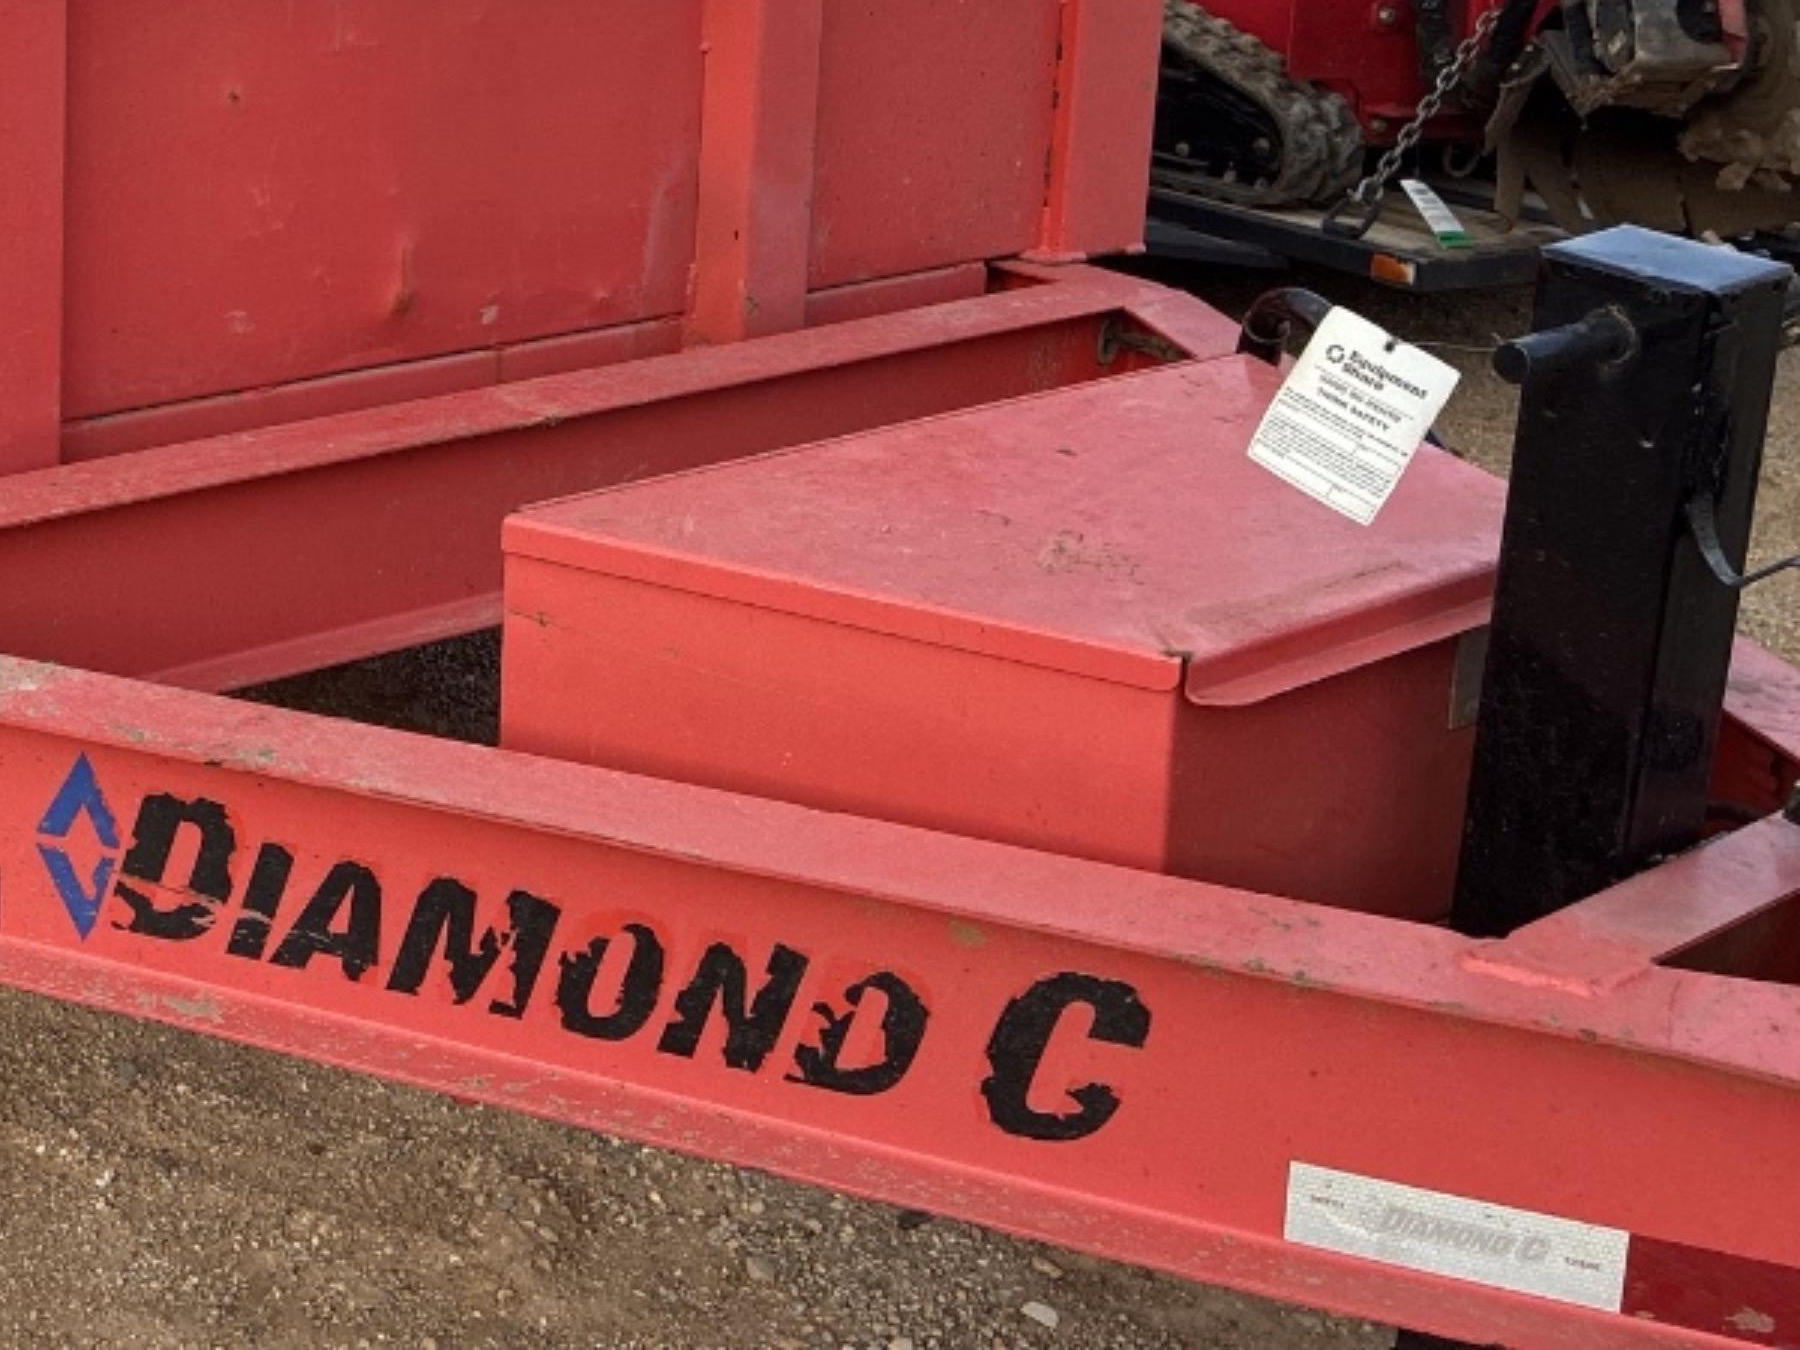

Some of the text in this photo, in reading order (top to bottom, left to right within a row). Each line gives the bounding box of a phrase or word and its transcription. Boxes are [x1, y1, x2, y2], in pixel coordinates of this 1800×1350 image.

[1349, 350, 1429, 400] Equipment
[113, 793, 1152, 1142] DIAMOND C
[1381, 1204, 1515, 1257] DIAMOND
